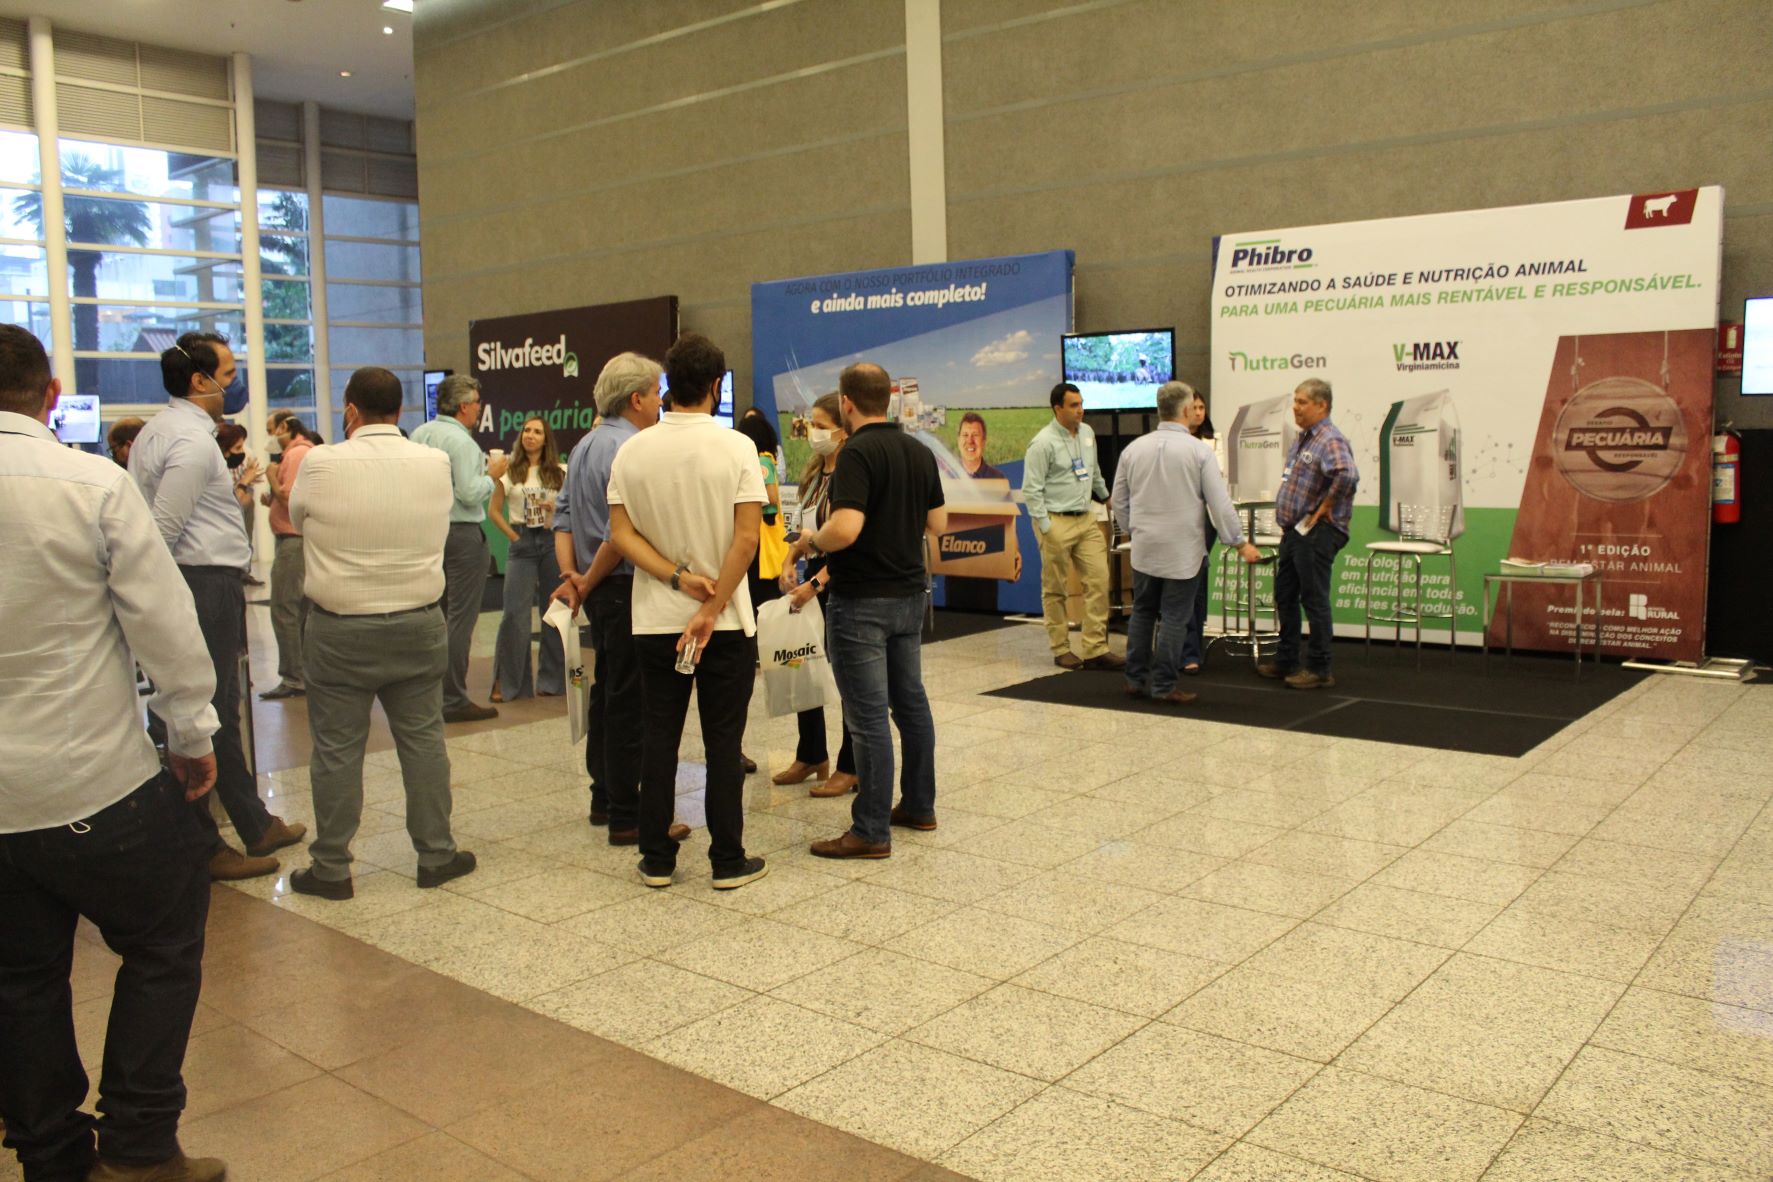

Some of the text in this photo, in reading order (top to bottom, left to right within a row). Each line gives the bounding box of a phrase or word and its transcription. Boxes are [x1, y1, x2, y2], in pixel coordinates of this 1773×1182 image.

[1231, 245, 1313, 268] Phibro
[785, 282, 817, 296] AGORA
[820, 280, 841, 292] COM
[845, 278, 852, 290] O
[854, 275, 890, 290] NOSSO
[955, 262, 1020, 280] INTEGRADO
[1225, 259, 1588, 298] OTIMIZANDO A SAÚDE E NUTRIÇÃO ANIMAL
[811, 282, 987, 314] e ainda mais completo!
[1220, 273, 1703, 318] PARA UMA PECUÁRIA MAIS RENTÁVEL E RESPONSÁVEL.
[477, 334, 566, 371] Silvafeed
[1392, 341, 1459, 362] V-MAX
[1396, 361, 1460, 373] Virginiamicina
[479, 404, 494, 433] A
[1571, 428, 1664, 447] PECUÁRIA
[941, 535, 986, 554] Elanco
[1597, 544, 1651, 558] EDIÇÃO
[1630, 561, 1682, 573] ANIMAL
[1214, 577, 1263, 591] Ngóco
[1341, 571, 1360, 580] em
[1420, 574, 1451, 586] para
[1338, 584, 1399, 597] eficincia
[1336, 598, 1351, 608] as
[1411, 602, 1478, 616] produão.
[1547, 604, 1596, 615] Premido
[1647, 610, 1680, 619] RURAL
[773, 642, 816, 662] Mosaic
